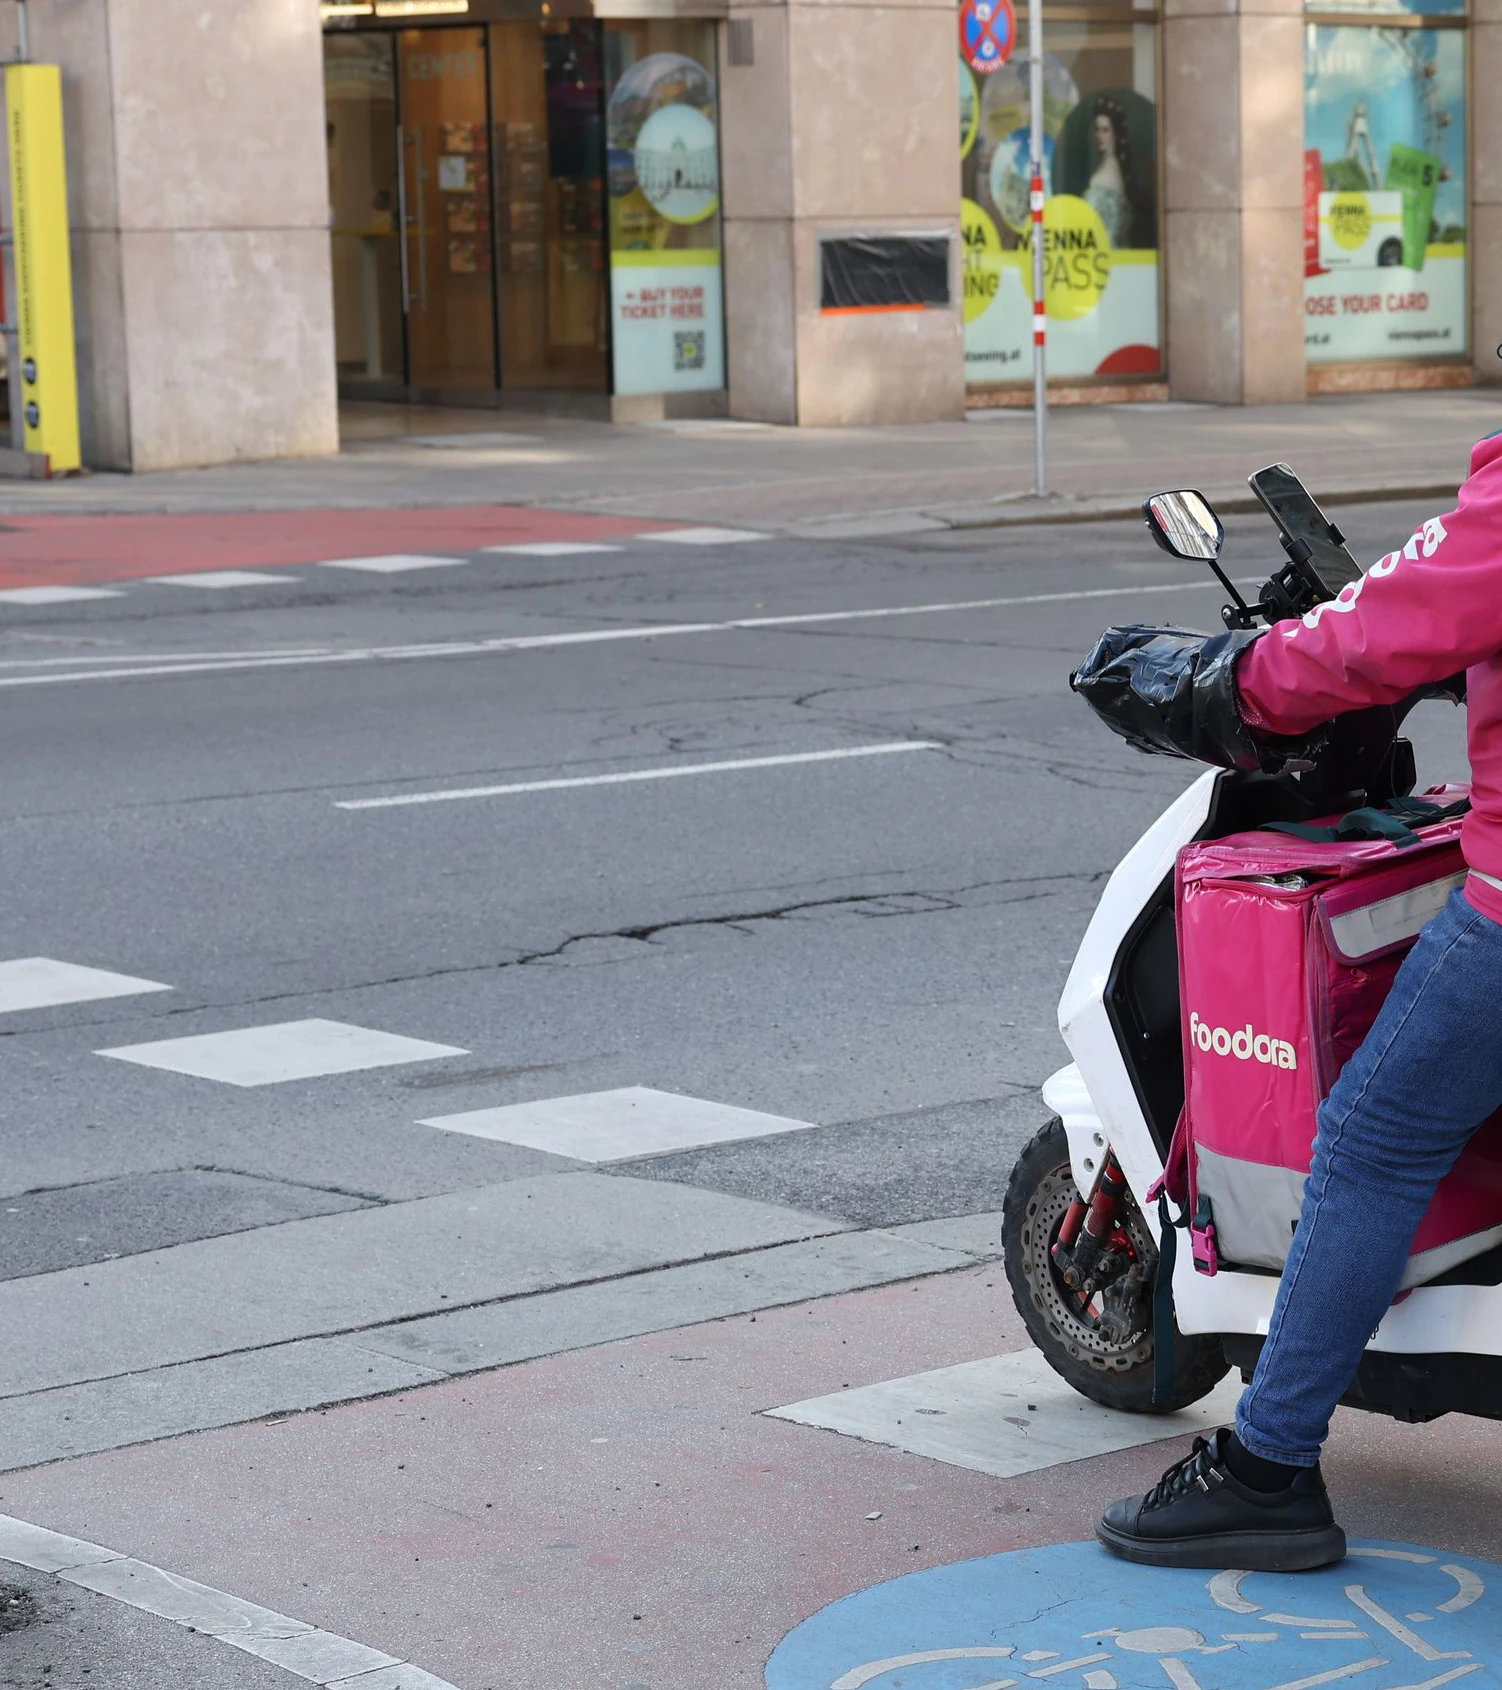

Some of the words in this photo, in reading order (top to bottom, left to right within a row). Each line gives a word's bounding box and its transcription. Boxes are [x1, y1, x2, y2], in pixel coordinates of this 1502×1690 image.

[672, 286, 704, 299] YOUR
[621, 304, 666, 318] TICKET
[671, 303, 704, 318] HERE
[1341, 294, 1382, 315] YOUR
[1386, 292, 1429, 313] CARD
[1190, 1012, 1297, 1070] foodora
